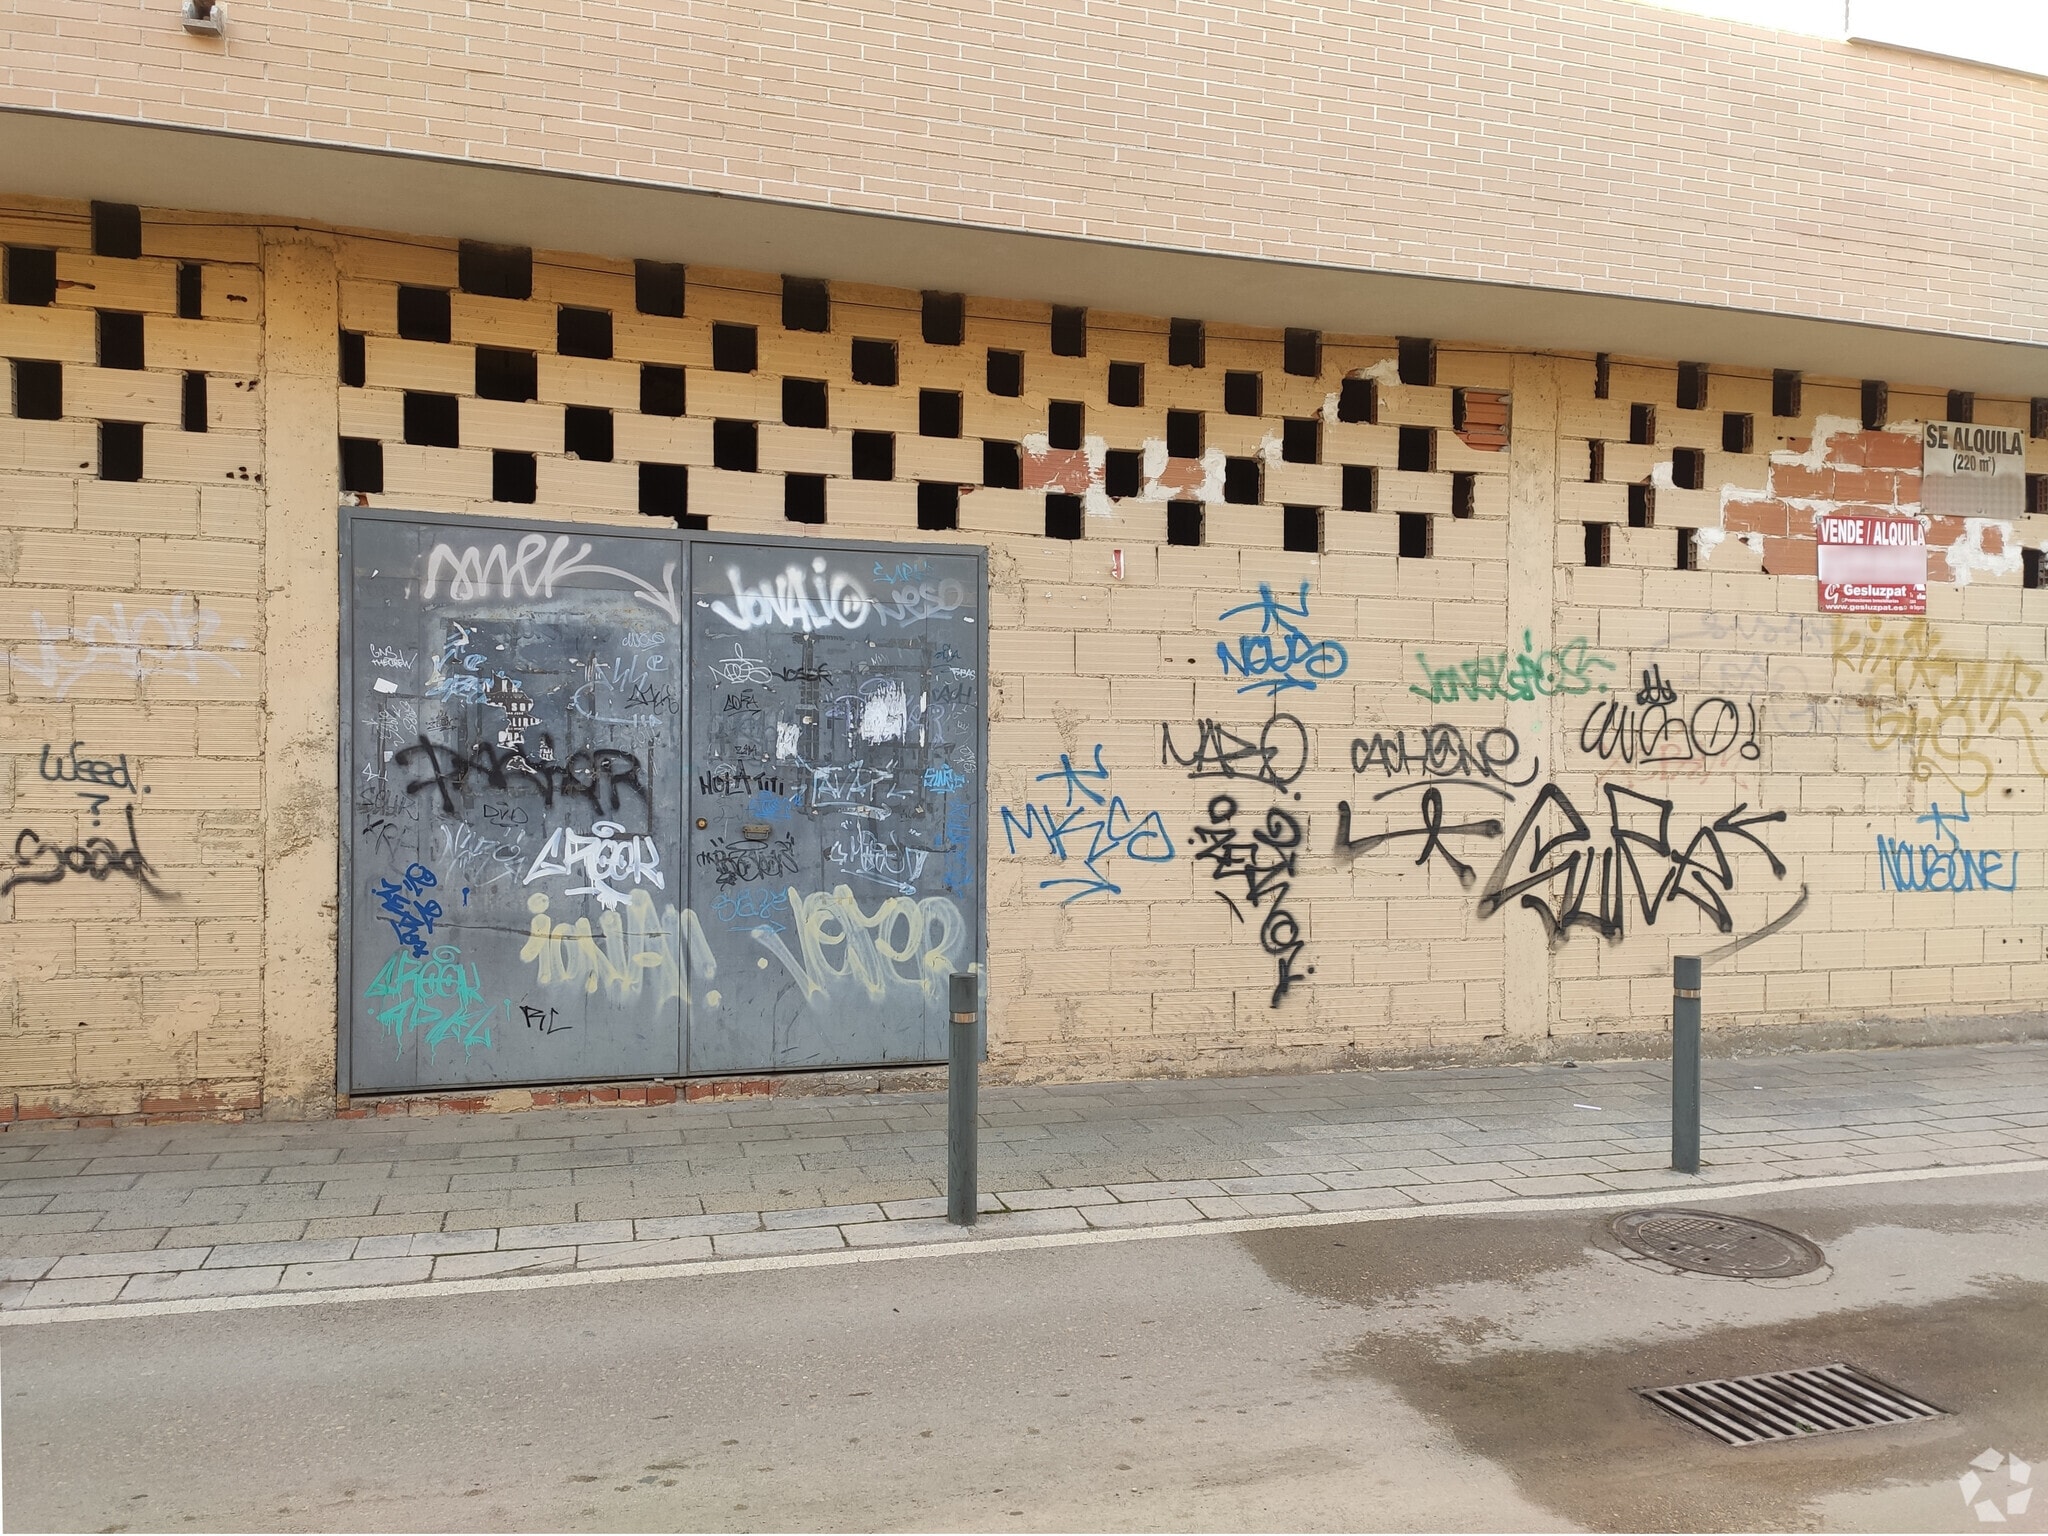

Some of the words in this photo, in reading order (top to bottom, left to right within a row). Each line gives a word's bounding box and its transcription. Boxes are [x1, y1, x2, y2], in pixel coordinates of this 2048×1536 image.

[1926, 424, 1949, 449] SE
[1953, 427, 2023, 455] ALQUILA
[1953, 453, 1977, 473] (220
[1821, 518, 1864, 544] VENDE
[1873, 521, 1926, 546] ALQUILA
[1843, 584, 1907, 599] Gesluzpat
[1825, 604, 1904, 612] www.gesluzpat.es
